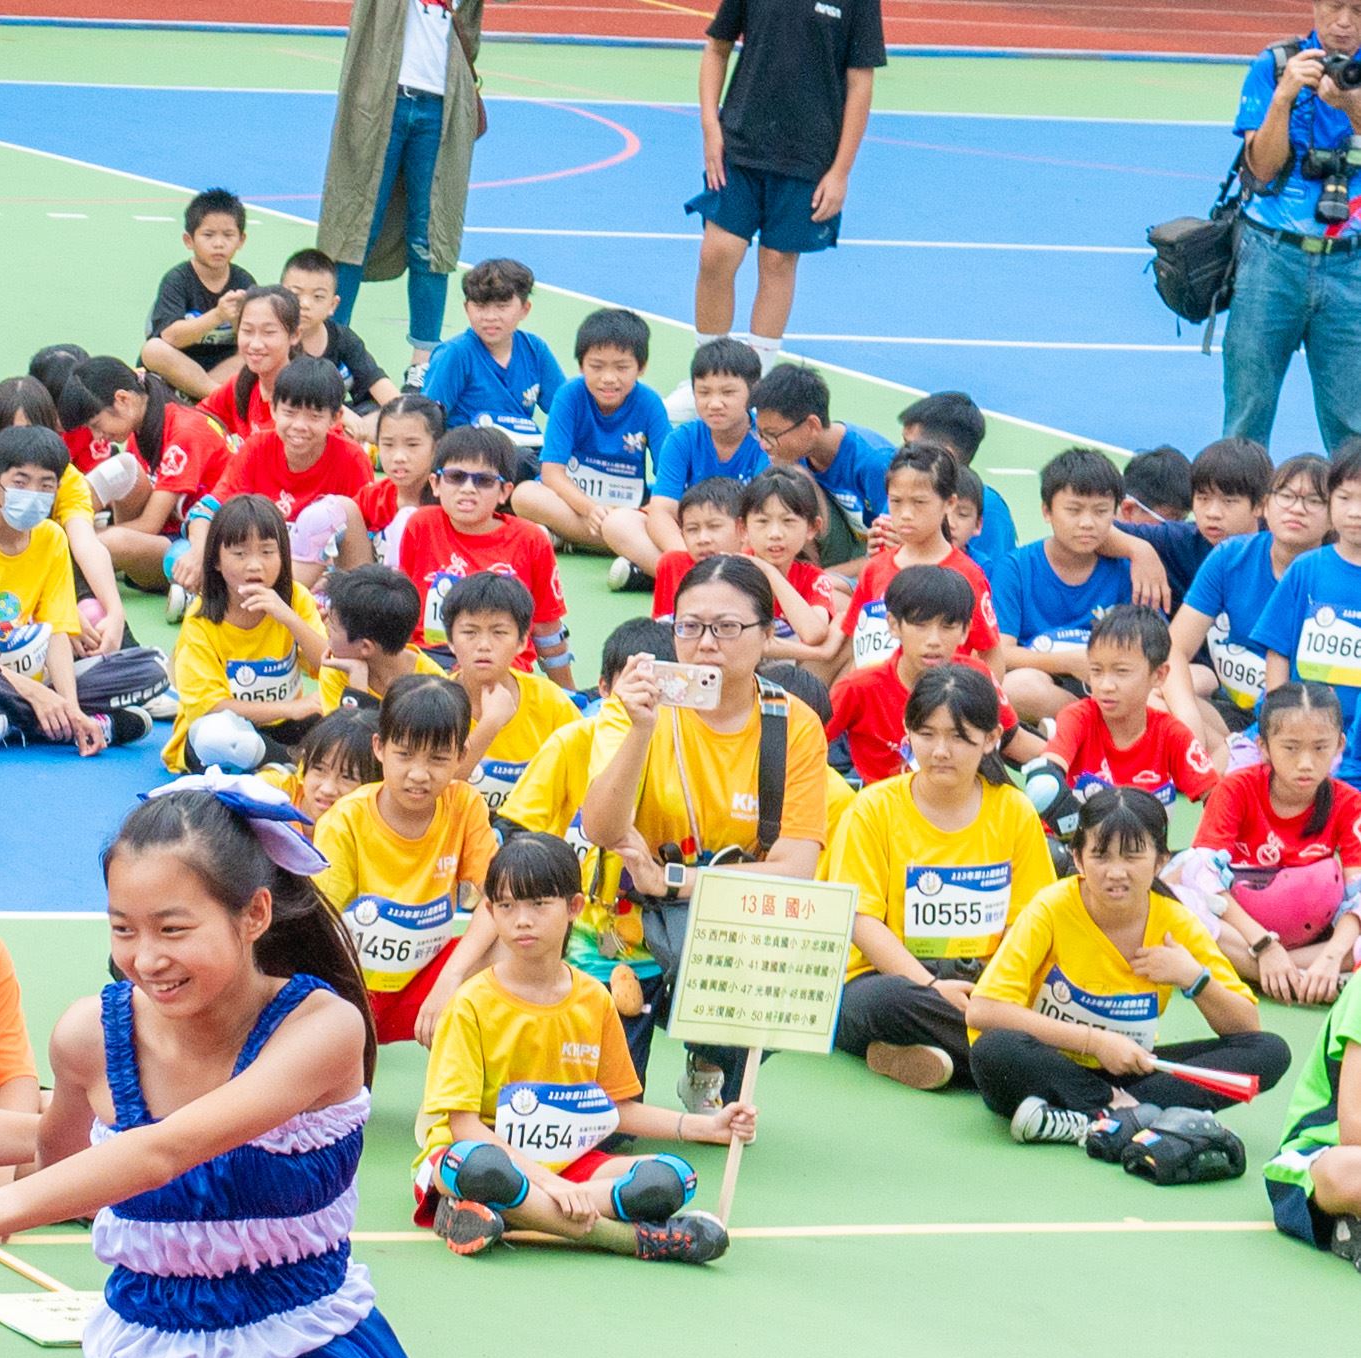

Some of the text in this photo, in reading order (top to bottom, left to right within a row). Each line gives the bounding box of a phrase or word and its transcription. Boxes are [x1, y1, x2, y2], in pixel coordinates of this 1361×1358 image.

[1217, 657, 1266, 689] 10962
[233, 682, 287, 702] 0556
[732, 791, 759, 811] KH
[785, 897, 816, 920] 國小
[912, 902, 982, 925] 10555
[351, 930, 412, 962] 1456
[505, 1122, 573, 1150] 11454
